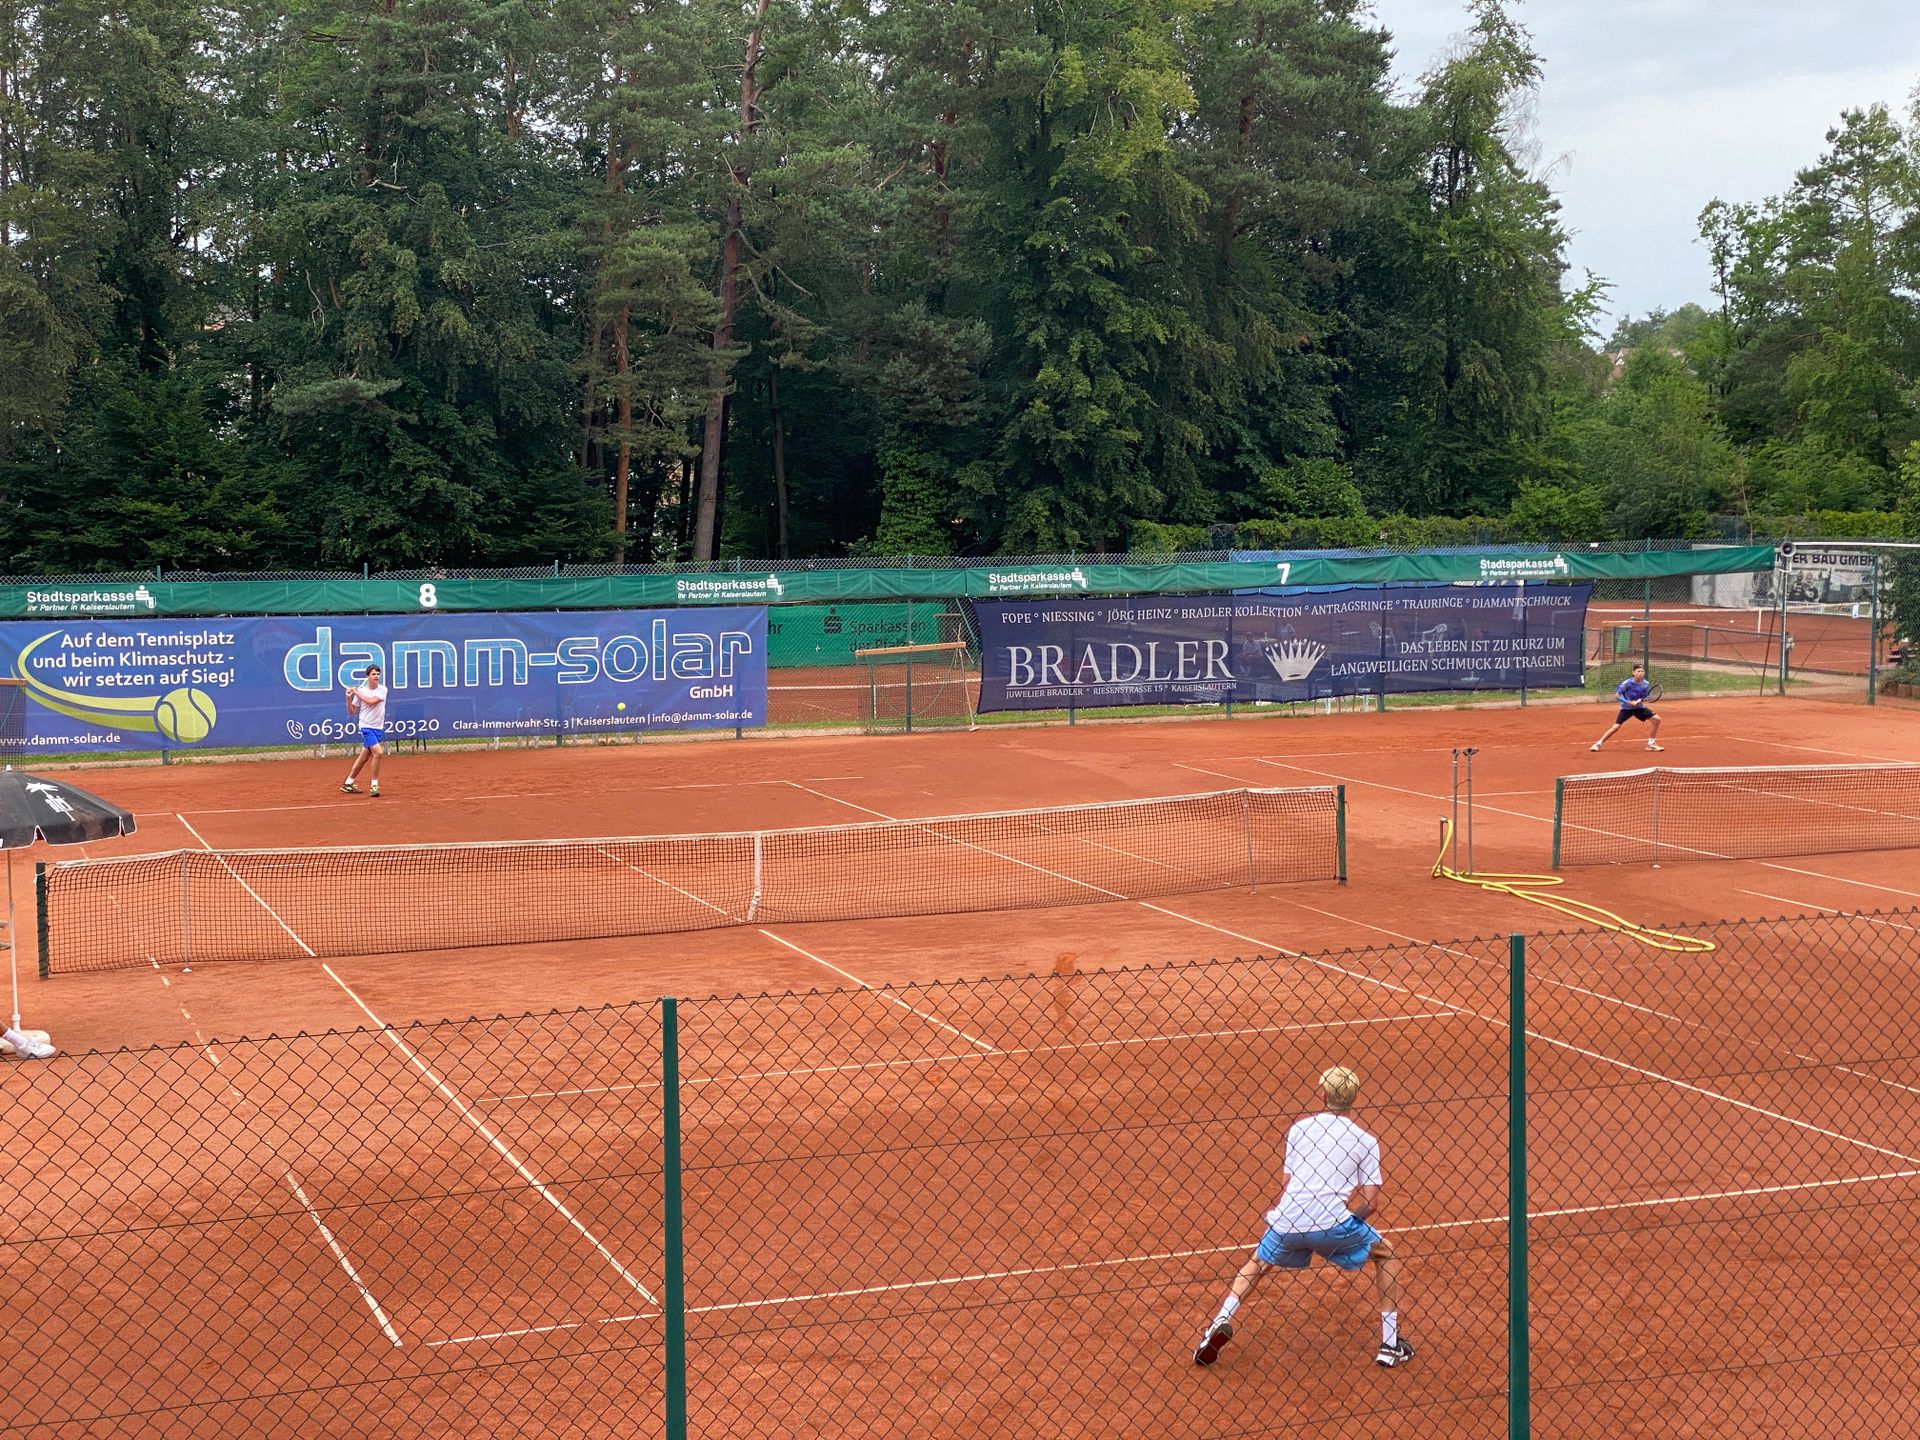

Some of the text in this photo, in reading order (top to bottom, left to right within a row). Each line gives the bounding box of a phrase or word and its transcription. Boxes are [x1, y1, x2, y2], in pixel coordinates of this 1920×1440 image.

[1480, 558, 1554, 570] Stadtsparkasse
[1813, 555, 1836, 565] BAU
[989, 572, 1071, 584] Stadtsparkasse
[1276, 563, 1291, 584] 7
[677, 579, 766, 591] Stadtsparkasse
[1030, 582, 1072, 590] Kaiserslautern
[27, 591, 134, 604] Stadtsparkasse
[419, 583, 437, 607] 8
[80, 603, 135, 611] Kaiserslautern
[1001, 612, 1031, 624] FOPE
[1042, 611, 1095, 622] NIESSING
[1107, 608, 1135, 623] JÖRG
[1137, 609, 1172, 620] HEINZ
[1181, 607, 1232, 619] BRADLER
[1234, 605, 1302, 617] KOLLEKTION
[1311, 600, 1393, 616] ANTRAGSRINGE
[1402, 597, 1464, 609] TRAURINGE
[1472, 596, 1572, 609] DIAMANTSCHMUCK
[61, 631, 235, 651] Auf dem Tennisplatz
[1400, 637, 1565, 653] DAS LEBEN IST ZU KURZ UM
[33, 652, 68, 669] und
[72, 652, 115, 668] beim
[119, 651, 225, 666] Klimaschutz
[284, 619, 752, 692] damm-solar
[1005, 640, 1236, 686] BRADLER
[1331, 655, 1565, 676] LANGWEILIGEN SCHMUCK ZU TRAGEN!
[63, 669, 234, 688] wir setzen auf Sieg!
[690, 685, 733, 699] GmbH
[1006, 689, 1045, 699] JUWELIER
[1046, 688, 1083, 697] BRADLER
[1093, 685, 1152, 695] RIESENSTRASSE
[1171, 682, 1237, 693] KAISERSLAUTERN
[308, 718, 361, 739] 0630
[453, 718, 561, 730] Clara-Immerwahr-Str.
[563, 720, 569, 729] 3
[576, 716, 645, 727] Kaiserslautern
[652, 710, 753, 723] info@damm-solar.de
